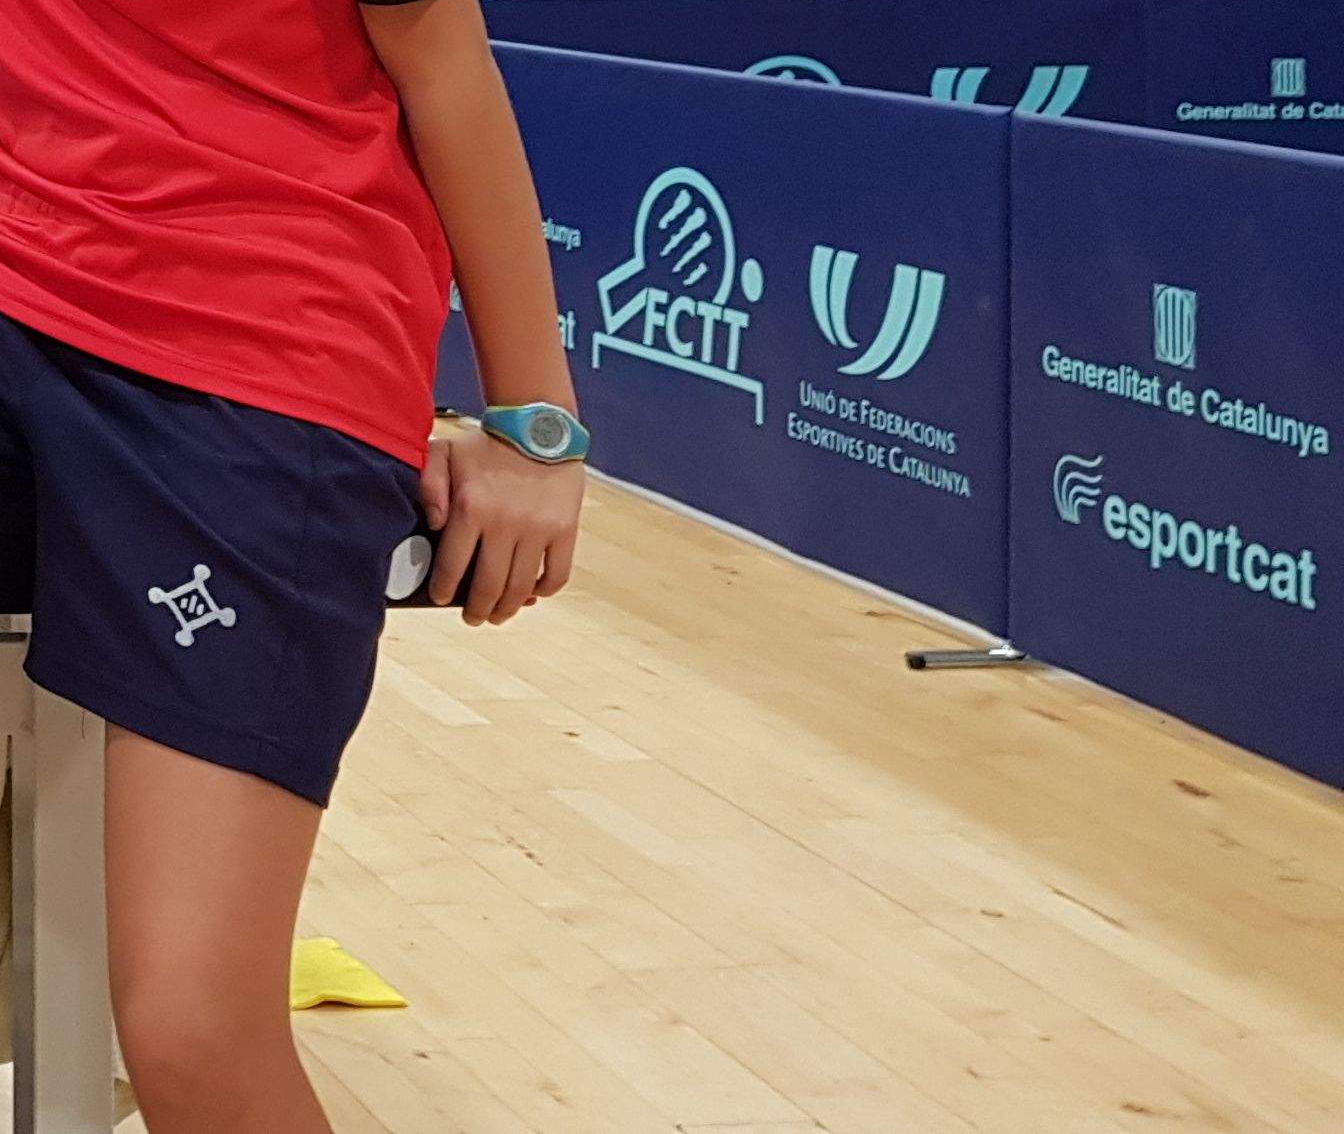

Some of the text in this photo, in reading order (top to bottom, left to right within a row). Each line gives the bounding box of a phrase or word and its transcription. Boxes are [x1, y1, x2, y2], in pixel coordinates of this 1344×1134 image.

[1176, 102, 1276, 121] Generalitat
[1281, 102, 1305, 120] de
[542, 218, 581, 250] alunya
[643, 287, 750, 372] FCTT
[800, 380, 957, 454] UNIÓ DE FEDERACIONS
[1042, 345, 1329, 457] Generalitat de Catalunya
[787, 412, 971, 497] ESPORTIVES DE CATALUNYA
[1103, 494, 1316, 609] esportcat
